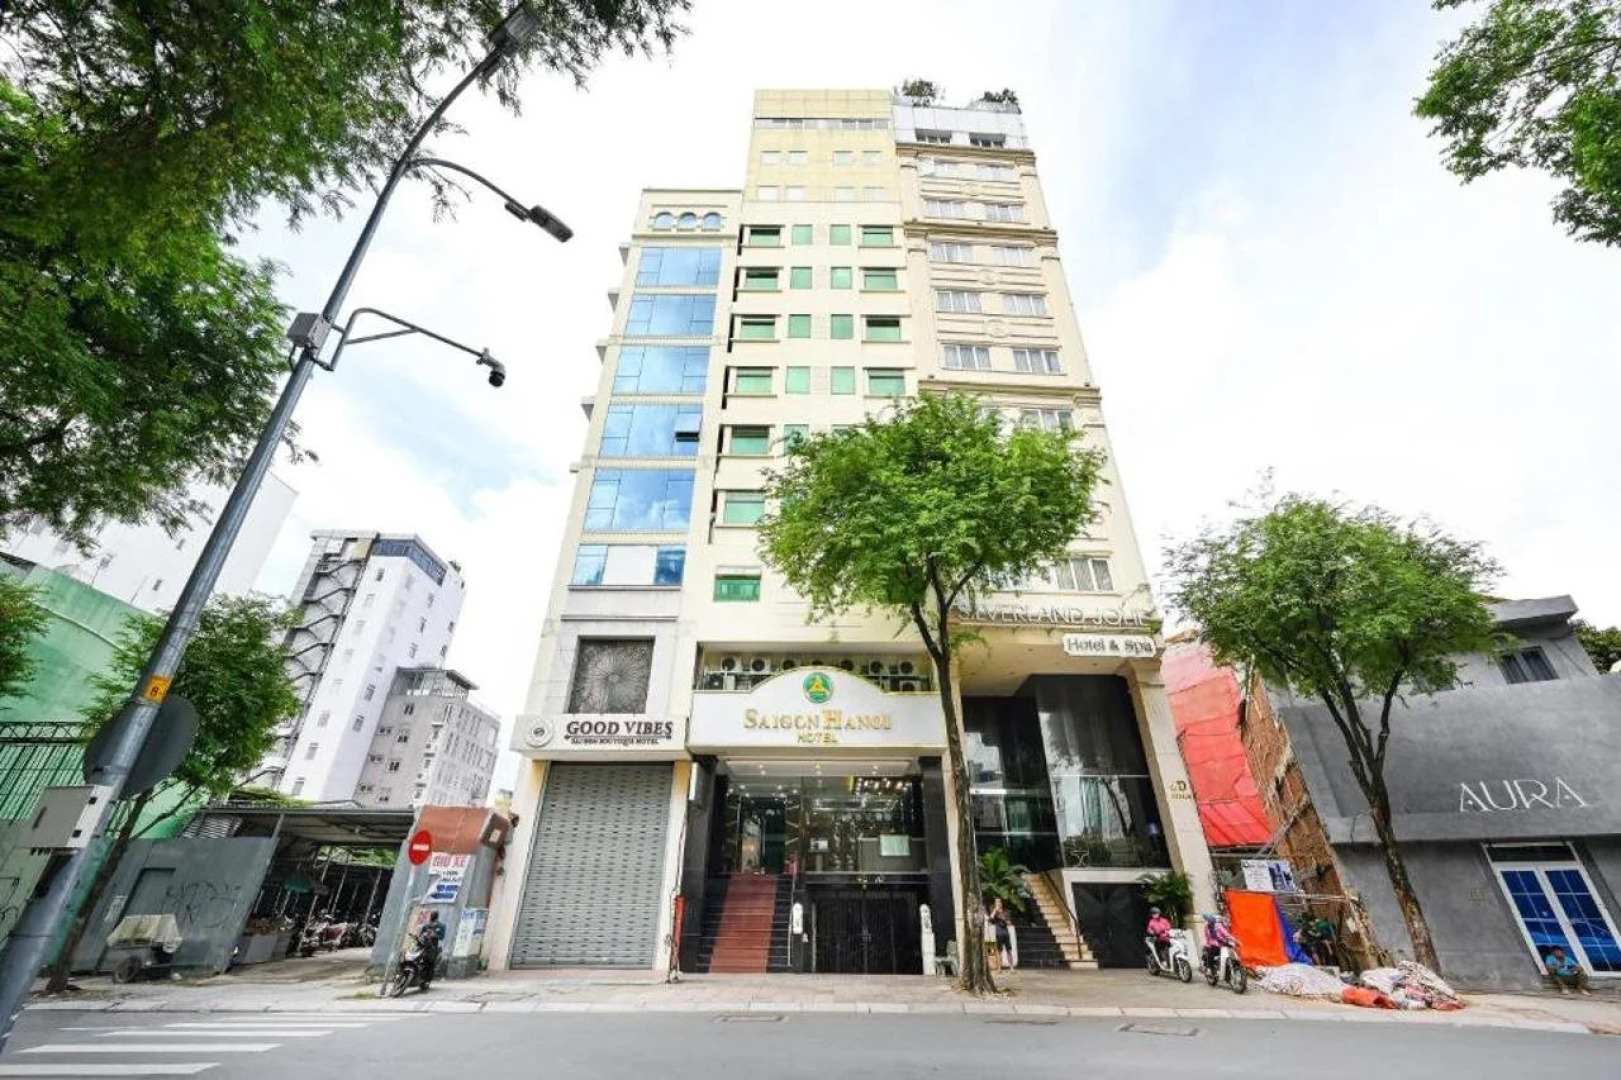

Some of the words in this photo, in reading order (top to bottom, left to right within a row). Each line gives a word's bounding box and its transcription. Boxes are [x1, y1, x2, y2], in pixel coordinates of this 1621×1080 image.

[1068, 637, 1105, 652] Hotel
[1109, 639, 1119, 651] &
[1125, 639, 1154, 655] Spa
[566, 721, 620, 735] GOOD
[624, 721, 673, 735] VIBES
[744, 708, 820, 729] SAIGON
[823, 709, 892, 730] HANOI
[798, 733, 838, 743] HOTEL
[1459, 777, 1590, 812] AURA
